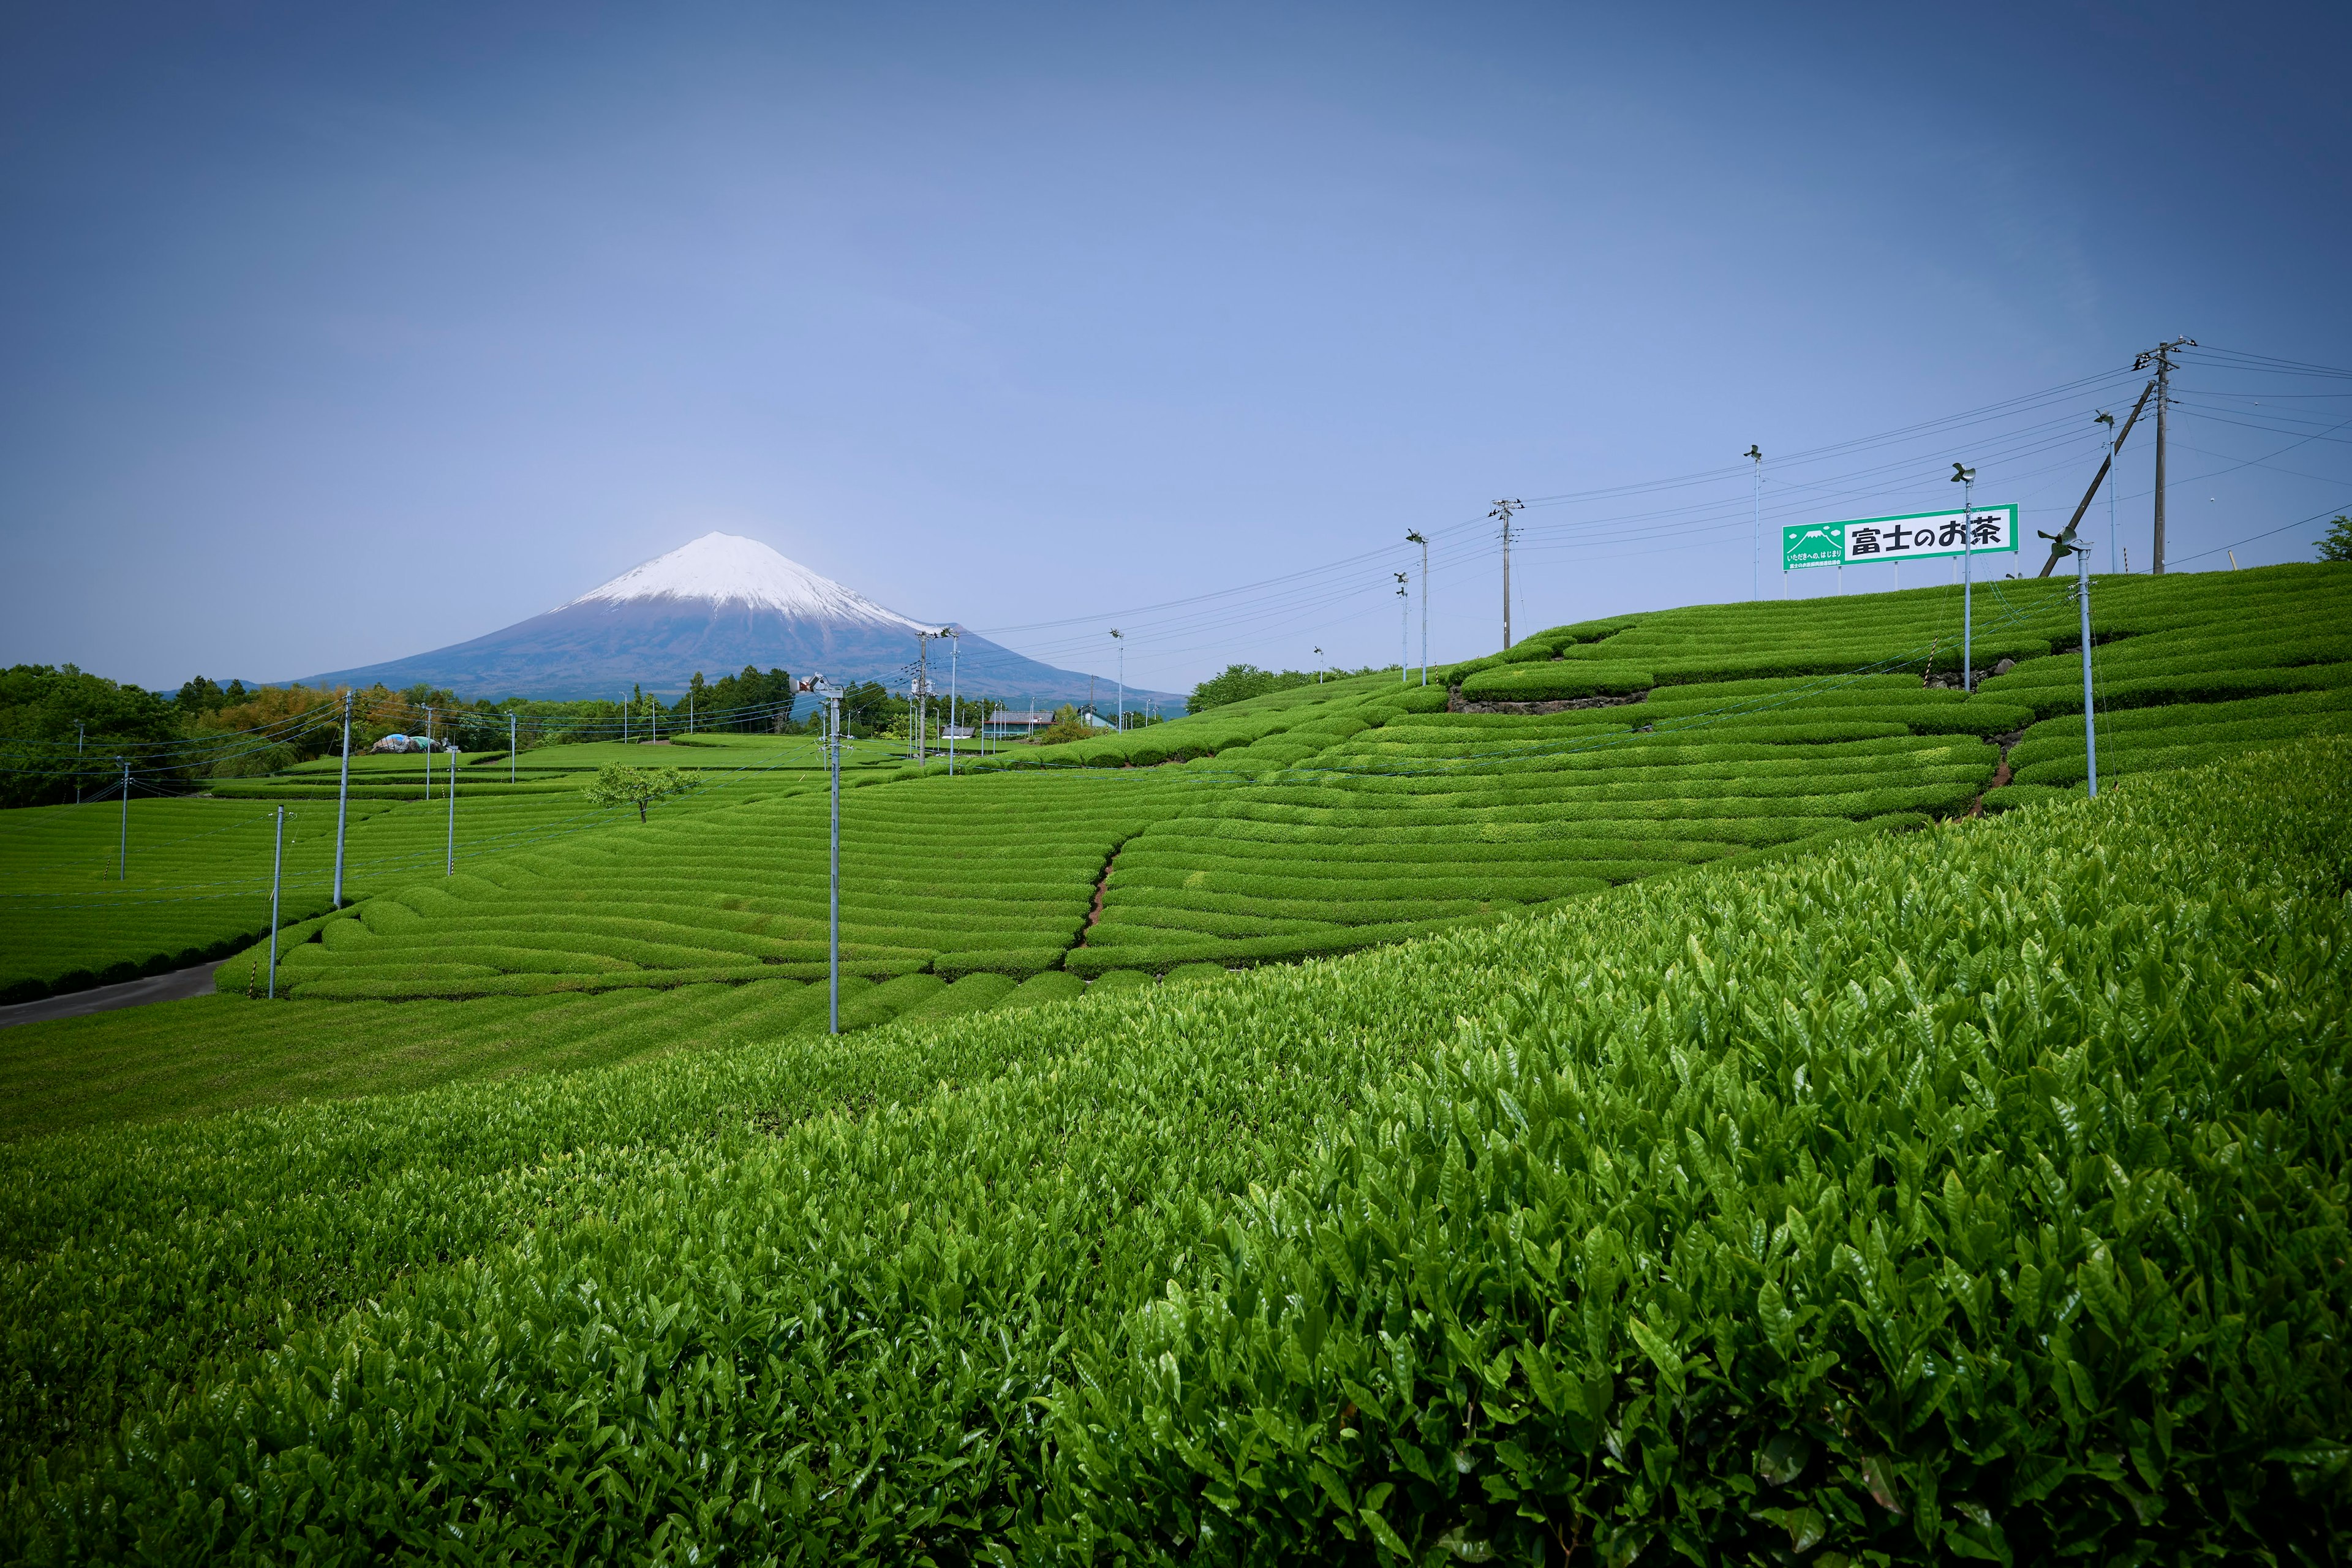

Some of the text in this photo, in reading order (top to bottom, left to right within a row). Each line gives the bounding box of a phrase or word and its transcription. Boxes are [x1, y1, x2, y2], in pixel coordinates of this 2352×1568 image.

[1852, 516, 2002, 556] 富士のお茶
[1787, 550, 1841, 562] いただきへの、はじまり
